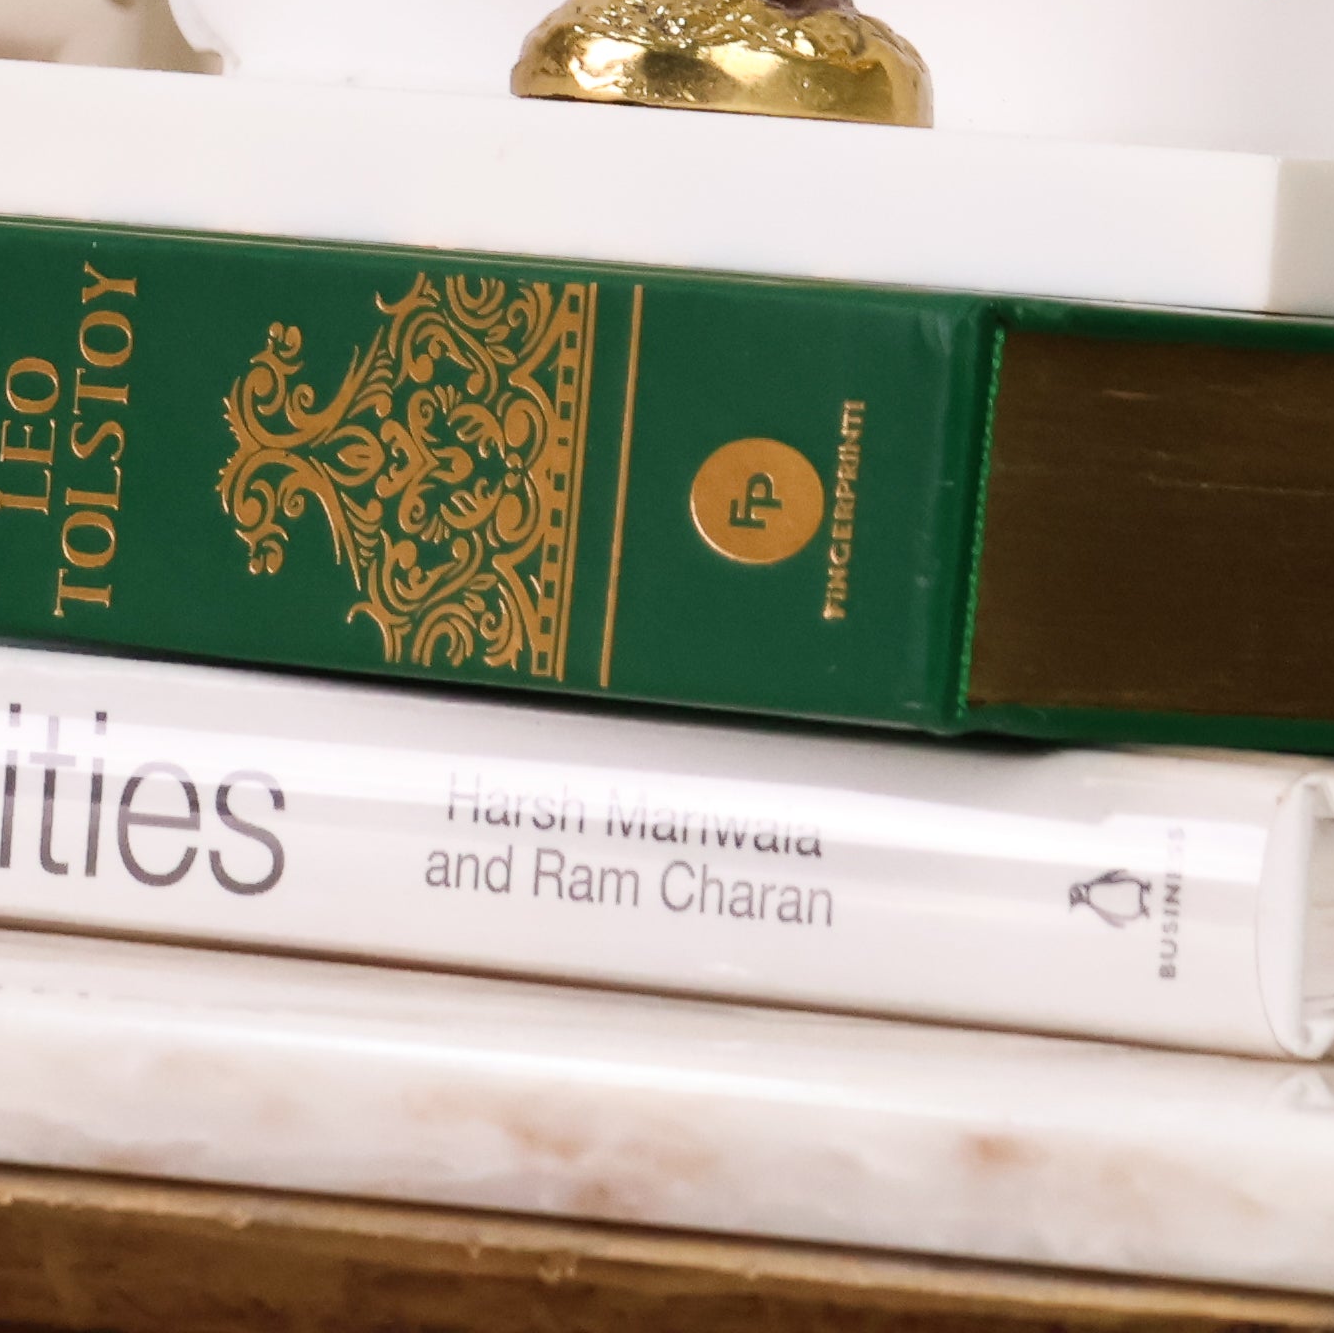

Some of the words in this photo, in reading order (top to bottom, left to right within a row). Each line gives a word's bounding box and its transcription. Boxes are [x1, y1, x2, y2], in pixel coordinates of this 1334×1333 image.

[53, 261, 137, 617] TOLSTOY
[447, 771, 585, 834] Harsh
[425, 845, 513, 894] and
[533, 848, 640, 907] Ram
[660, 860, 834, 927] Charan
